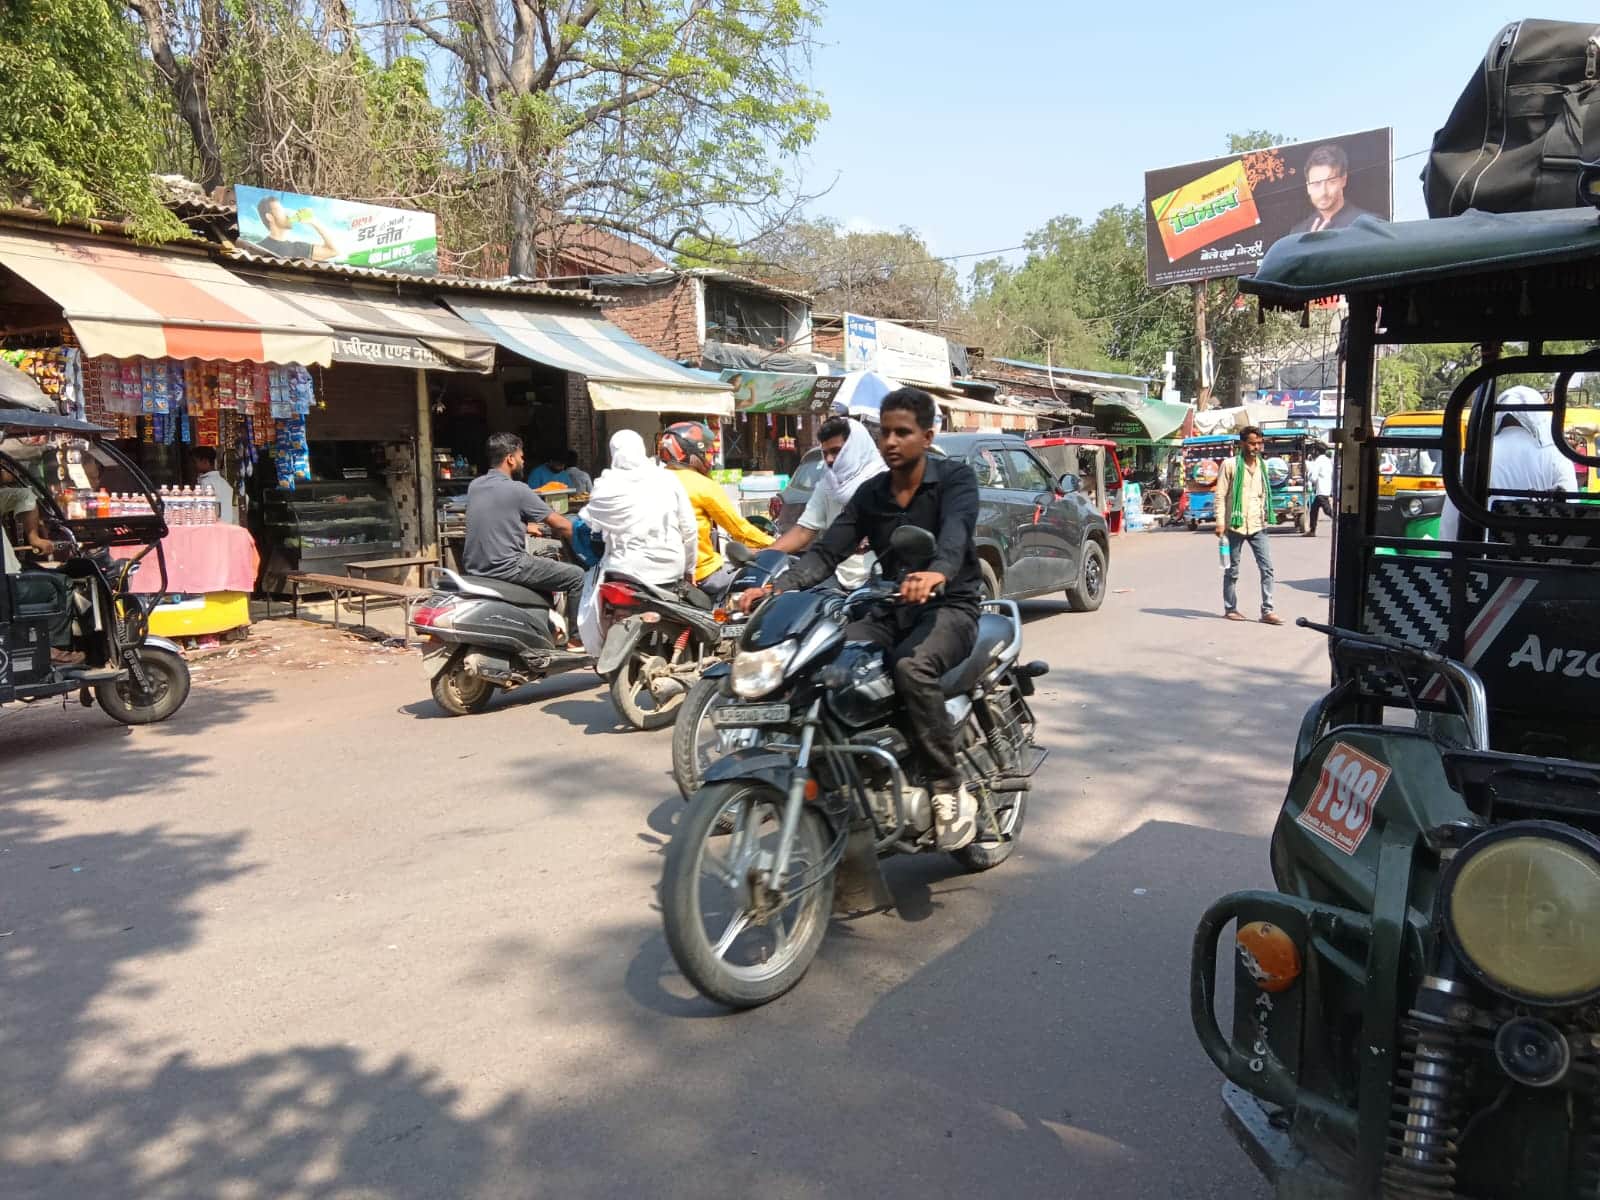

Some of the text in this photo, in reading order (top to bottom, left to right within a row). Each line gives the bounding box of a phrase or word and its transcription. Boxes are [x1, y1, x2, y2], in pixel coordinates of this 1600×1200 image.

[357, 224, 377, 242] डर
[376, 227, 404, 245] जीत
[342, 337, 382, 361] स्वीट्स
[384, 342, 411, 361] एण्ड
[1317, 753, 1378, 830] 198
